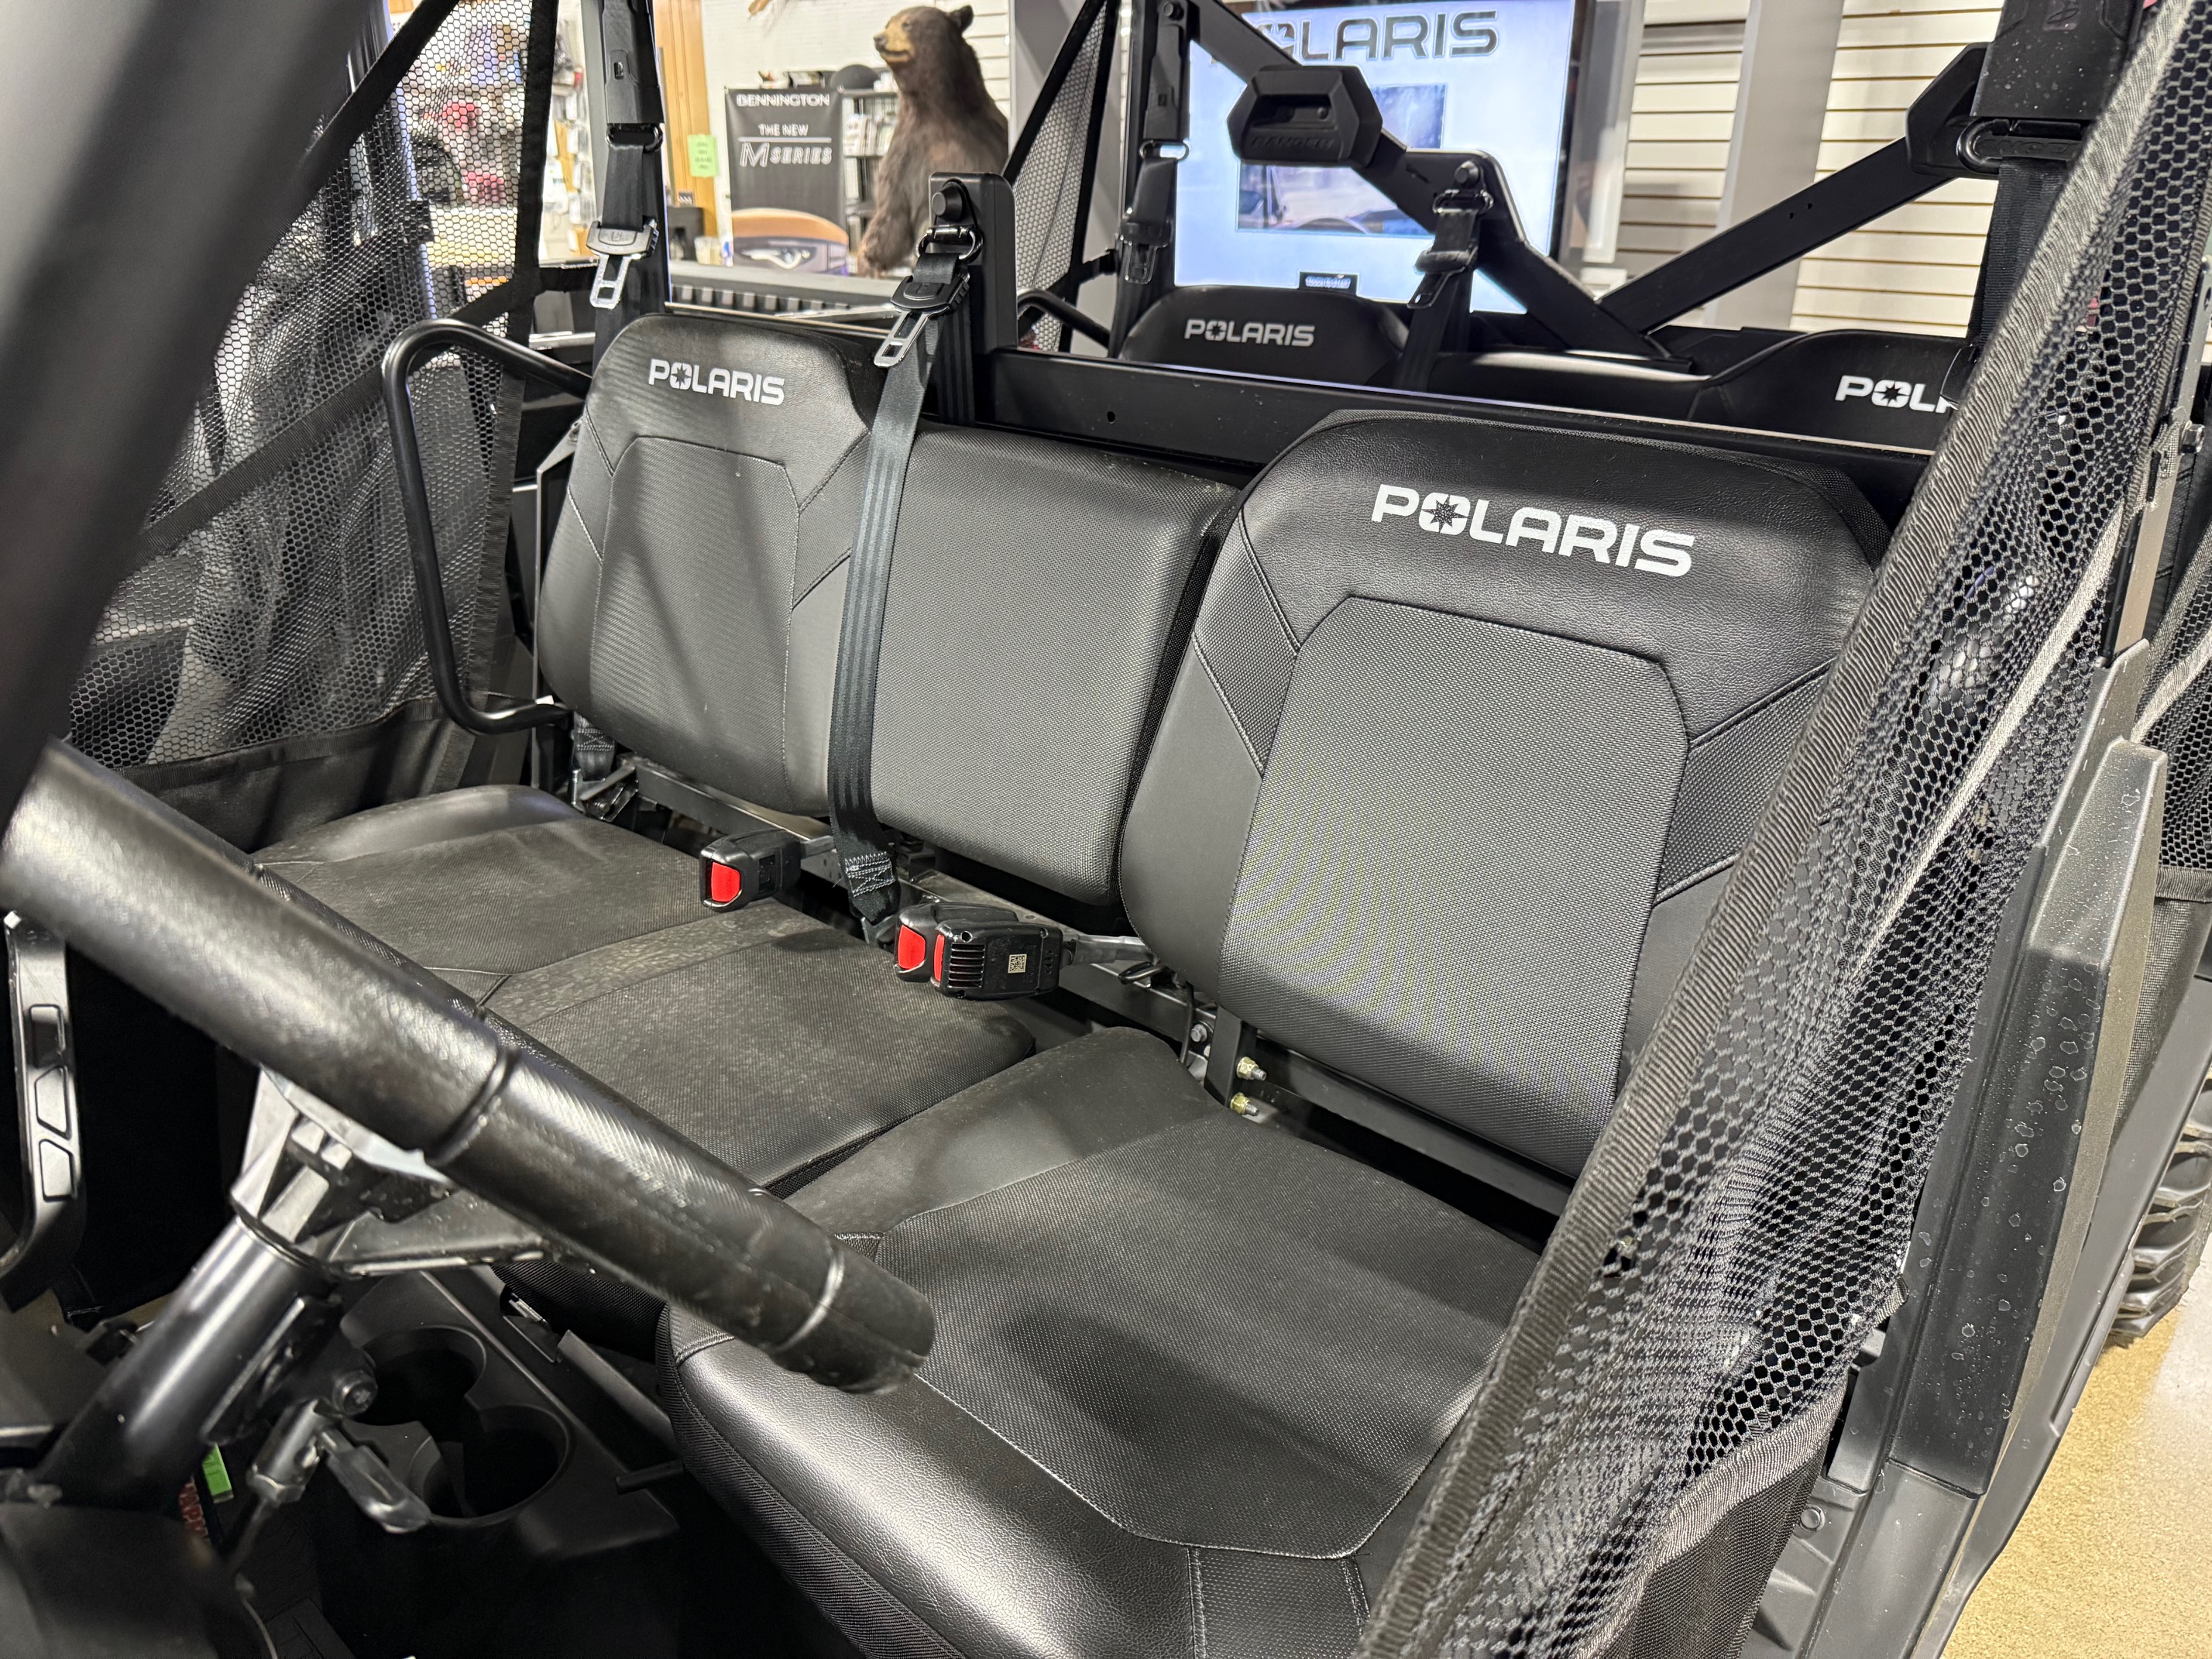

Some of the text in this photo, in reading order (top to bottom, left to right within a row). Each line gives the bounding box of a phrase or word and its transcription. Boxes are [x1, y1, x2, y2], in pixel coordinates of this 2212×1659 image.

[736, 94, 830, 107] BENNINGTON
[758, 123, 809, 136] THE NEW
[770, 146, 833, 165] SERIES
[1183, 318, 1316, 348] POLARIS
[648, 358, 785, 406] POLARIS
[1371, 483, 1695, 577] POLARIS
